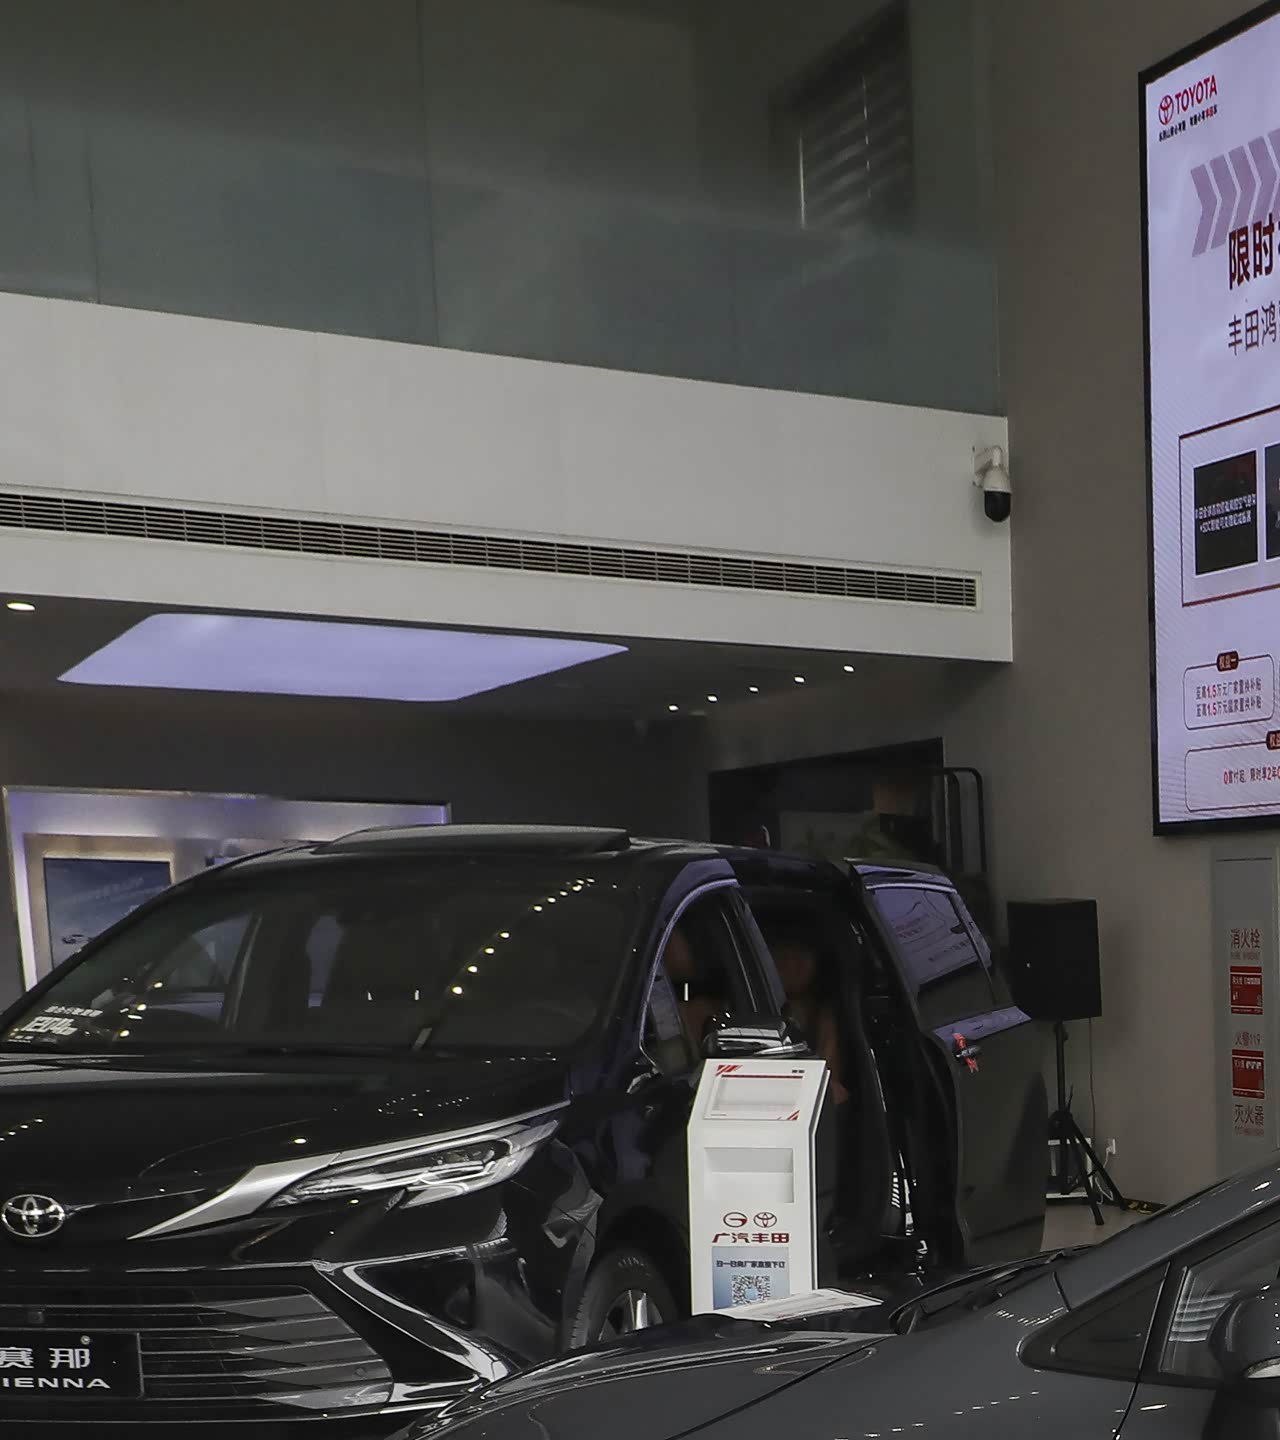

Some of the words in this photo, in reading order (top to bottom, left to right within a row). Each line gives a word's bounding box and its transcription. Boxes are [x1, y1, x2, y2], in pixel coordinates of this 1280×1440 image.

[1175, 75, 1217, 114] TOYOTA
[1230, 928, 1261, 949] 消火栓
[1234, 1104, 1265, 1126] 灭火器
[712, 1232, 790, 1244] 广汽丰田
[0, 1377, 111, 1389] IENNA
